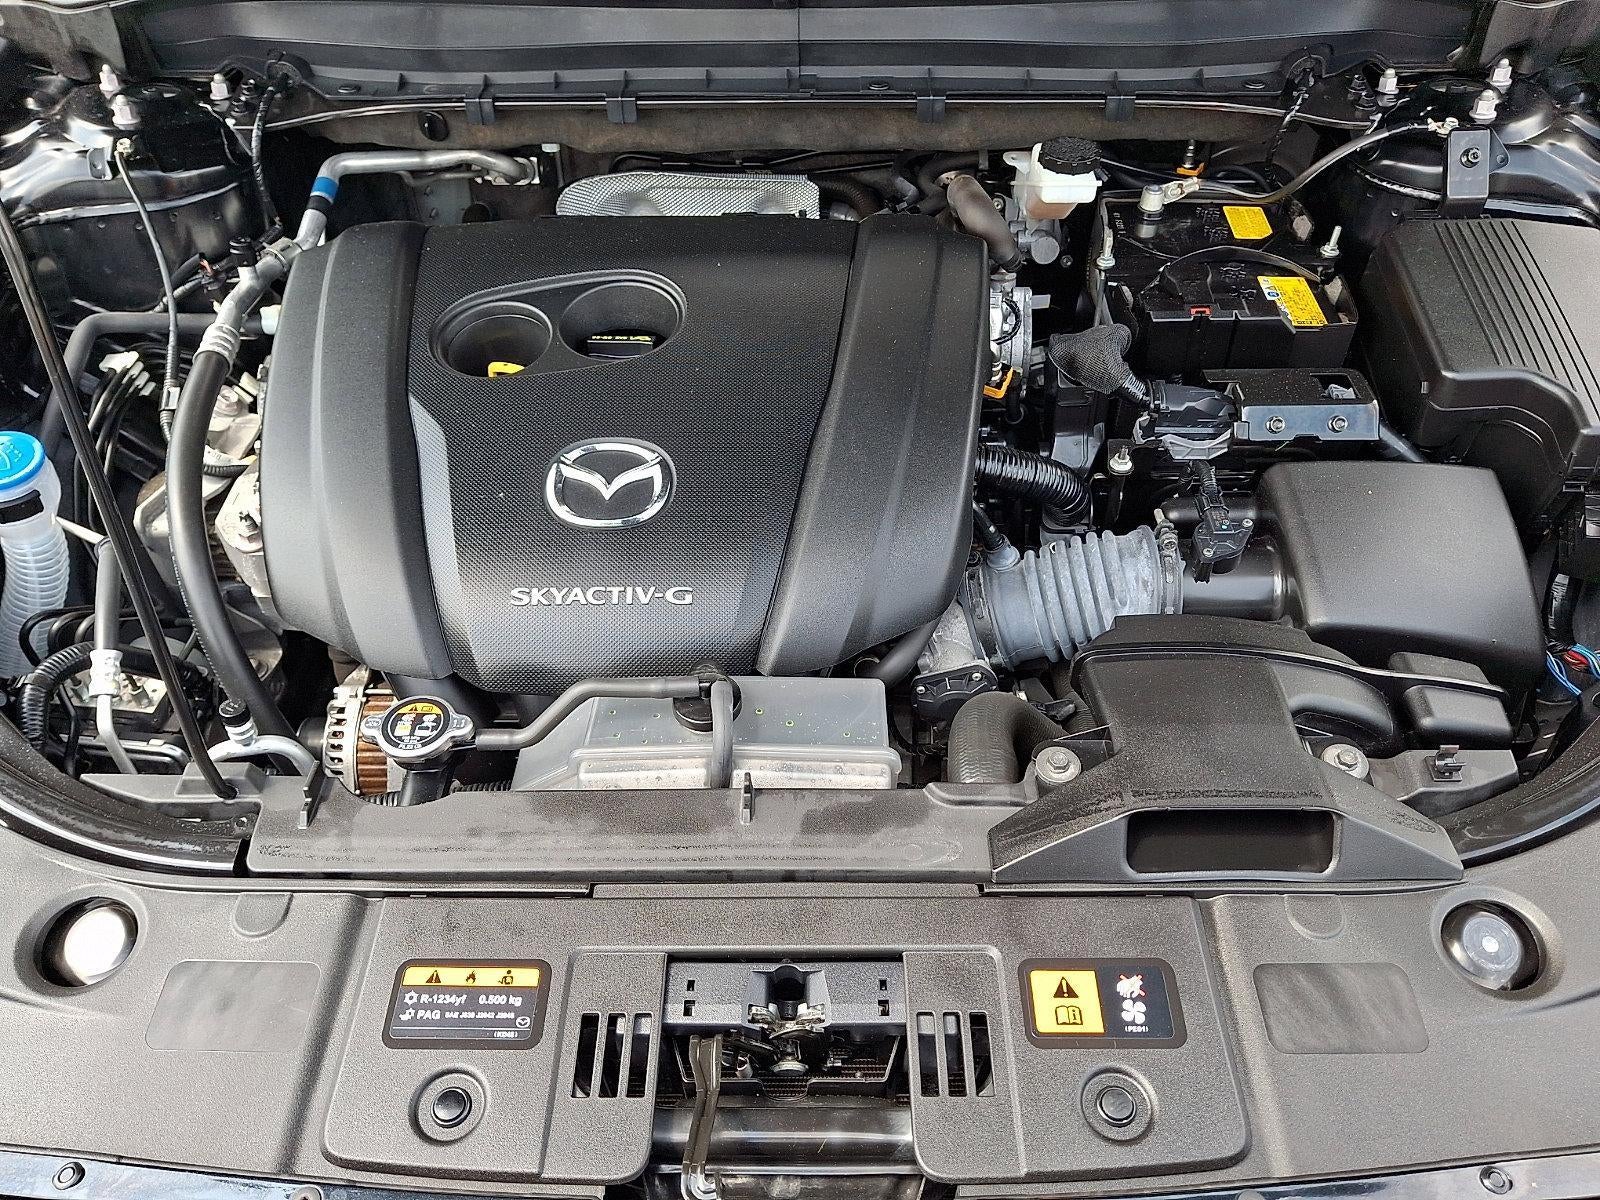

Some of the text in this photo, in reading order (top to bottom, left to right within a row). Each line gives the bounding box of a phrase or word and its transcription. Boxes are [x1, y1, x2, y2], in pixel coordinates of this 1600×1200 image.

[510, 586, 694, 606] SKYACTIV-G
[420, 994, 523, 1007] R-1234yf 0.500 kg
[417, 1009, 441, 1020] PAG
